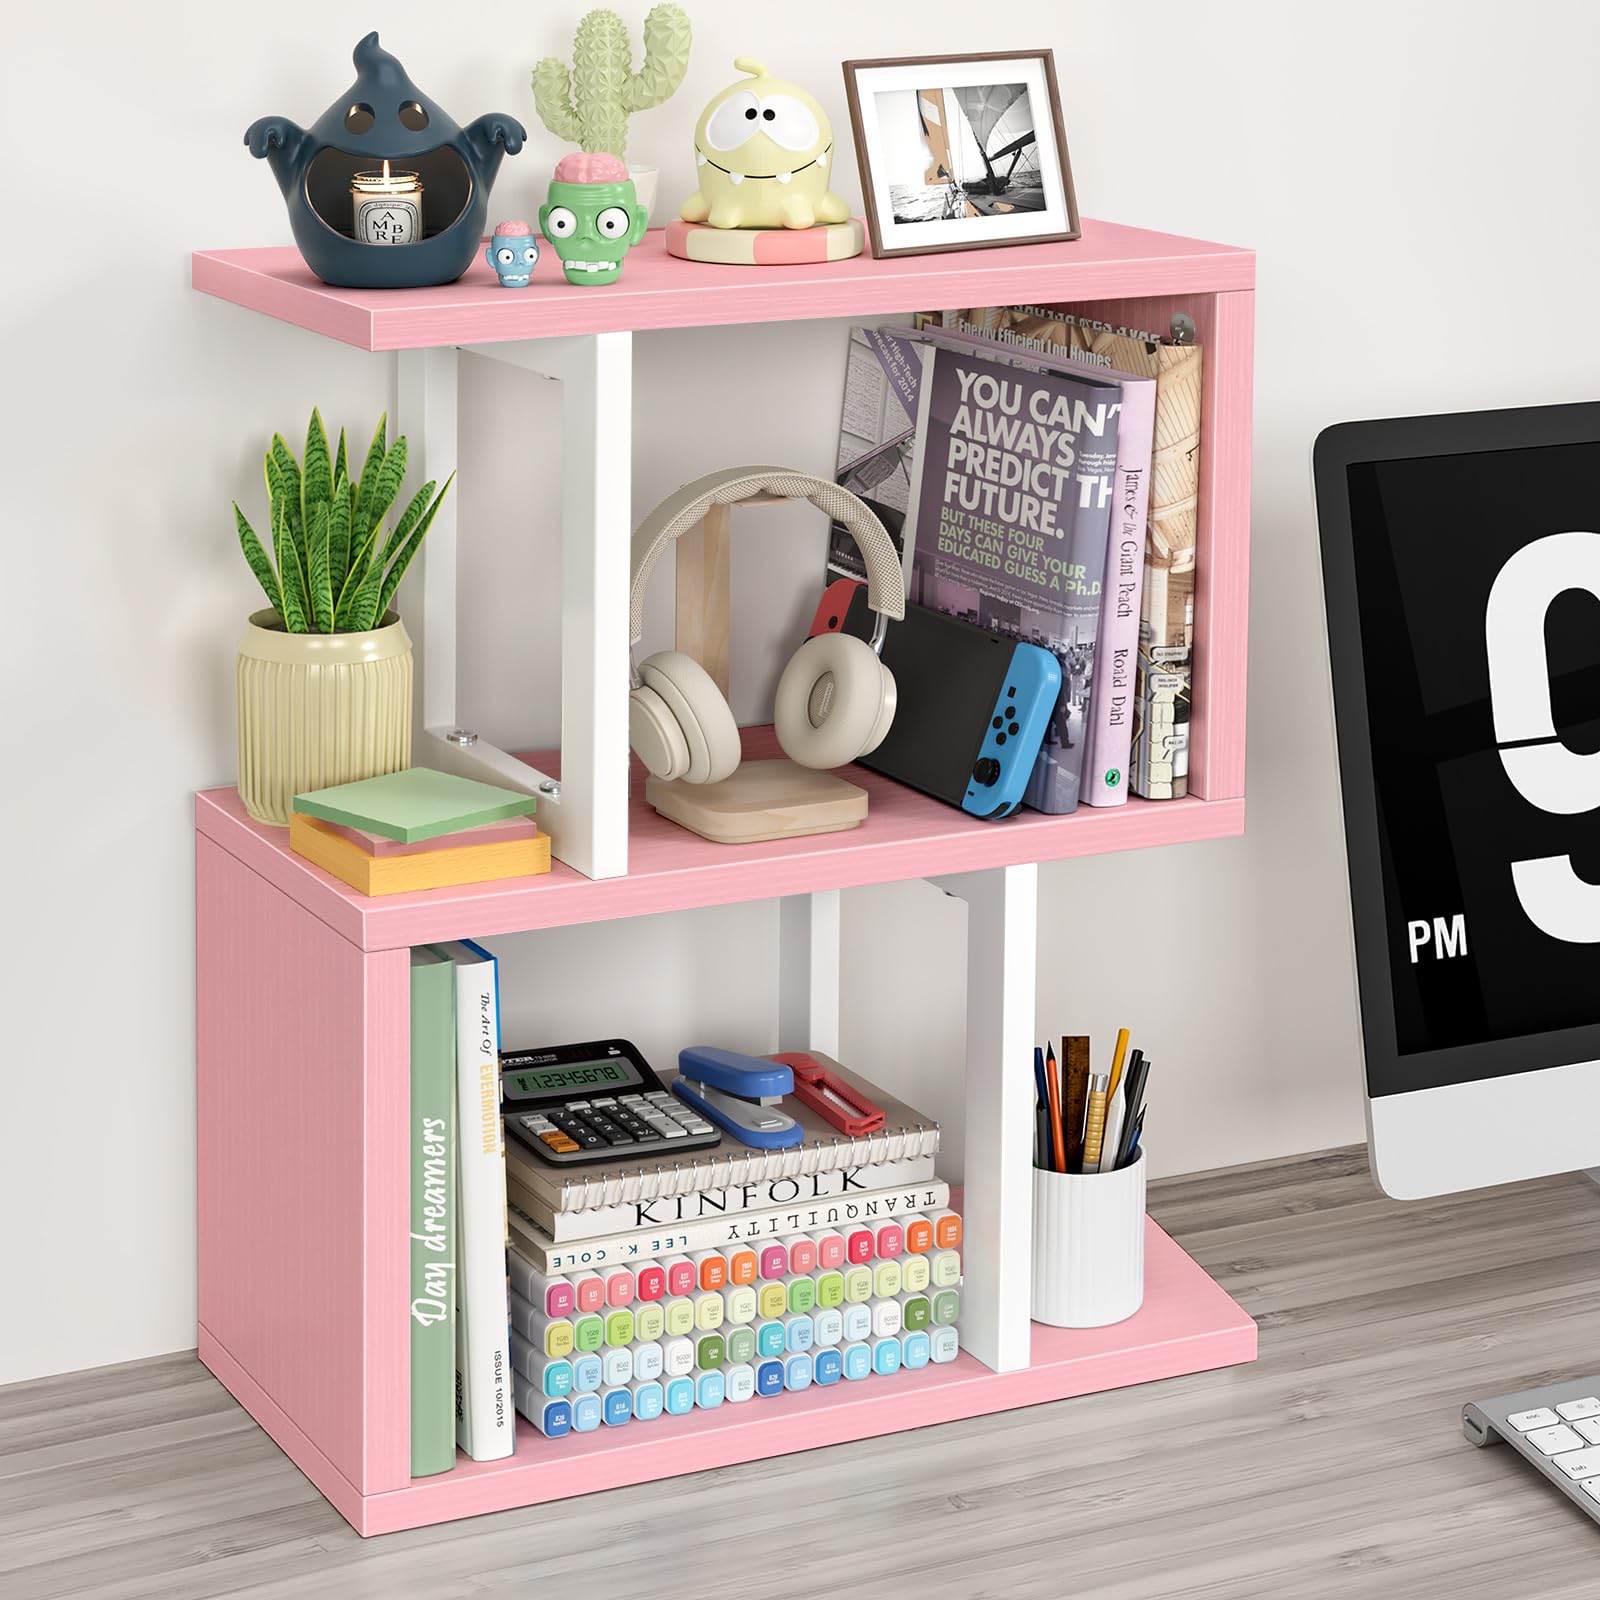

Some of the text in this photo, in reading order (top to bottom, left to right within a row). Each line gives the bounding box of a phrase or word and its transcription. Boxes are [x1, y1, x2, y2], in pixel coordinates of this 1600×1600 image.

[872, 330, 915, 402] orecast for 2014
[890, 341, 918, 389] High-Tech
[1000, 328, 1045, 353] Efficient
[1070, 343, 1112, 369] Homes
[956, 368, 1121, 437] YOU CAN'
[949, 404, 1076, 467] ALWAYS
[948, 437, 1069, 501] PREDICT
[1119, 465, 1142, 502] James
[941, 506, 1045, 552] BUT THESE FOUR
[944, 471, 1065, 540] FUTURE.
[1124, 504, 1138, 520] &
[938, 537, 1001, 570] EDUCATED
[1004, 560, 1047, 586] GUESS
[1049, 576, 1060, 591] A
[939, 522, 1086, 580] DAYS CAN GIVE YOUR
[1120, 541, 1138, 576] Giant
[1117, 582, 1136, 618] Peach
[1113, 648, 1128, 689] Roald
[1109, 695, 1126, 727] Dahl
[1408, 914, 1467, 963] PM
[479, 993, 497, 1154] The Art Of EVERMOTION
[533, 1066, 619, 1089] 1.2345678
[635, 1166, 867, 1226] KINFOLK
[727, 1191, 936, 1239] TRANQUILITY
[410, 1117, 456, 1327] Day dreamers
[553, 1235, 688, 1268] LEE K. COLE
[494, 1350, 504, 1428] ISSUE 10/2015
